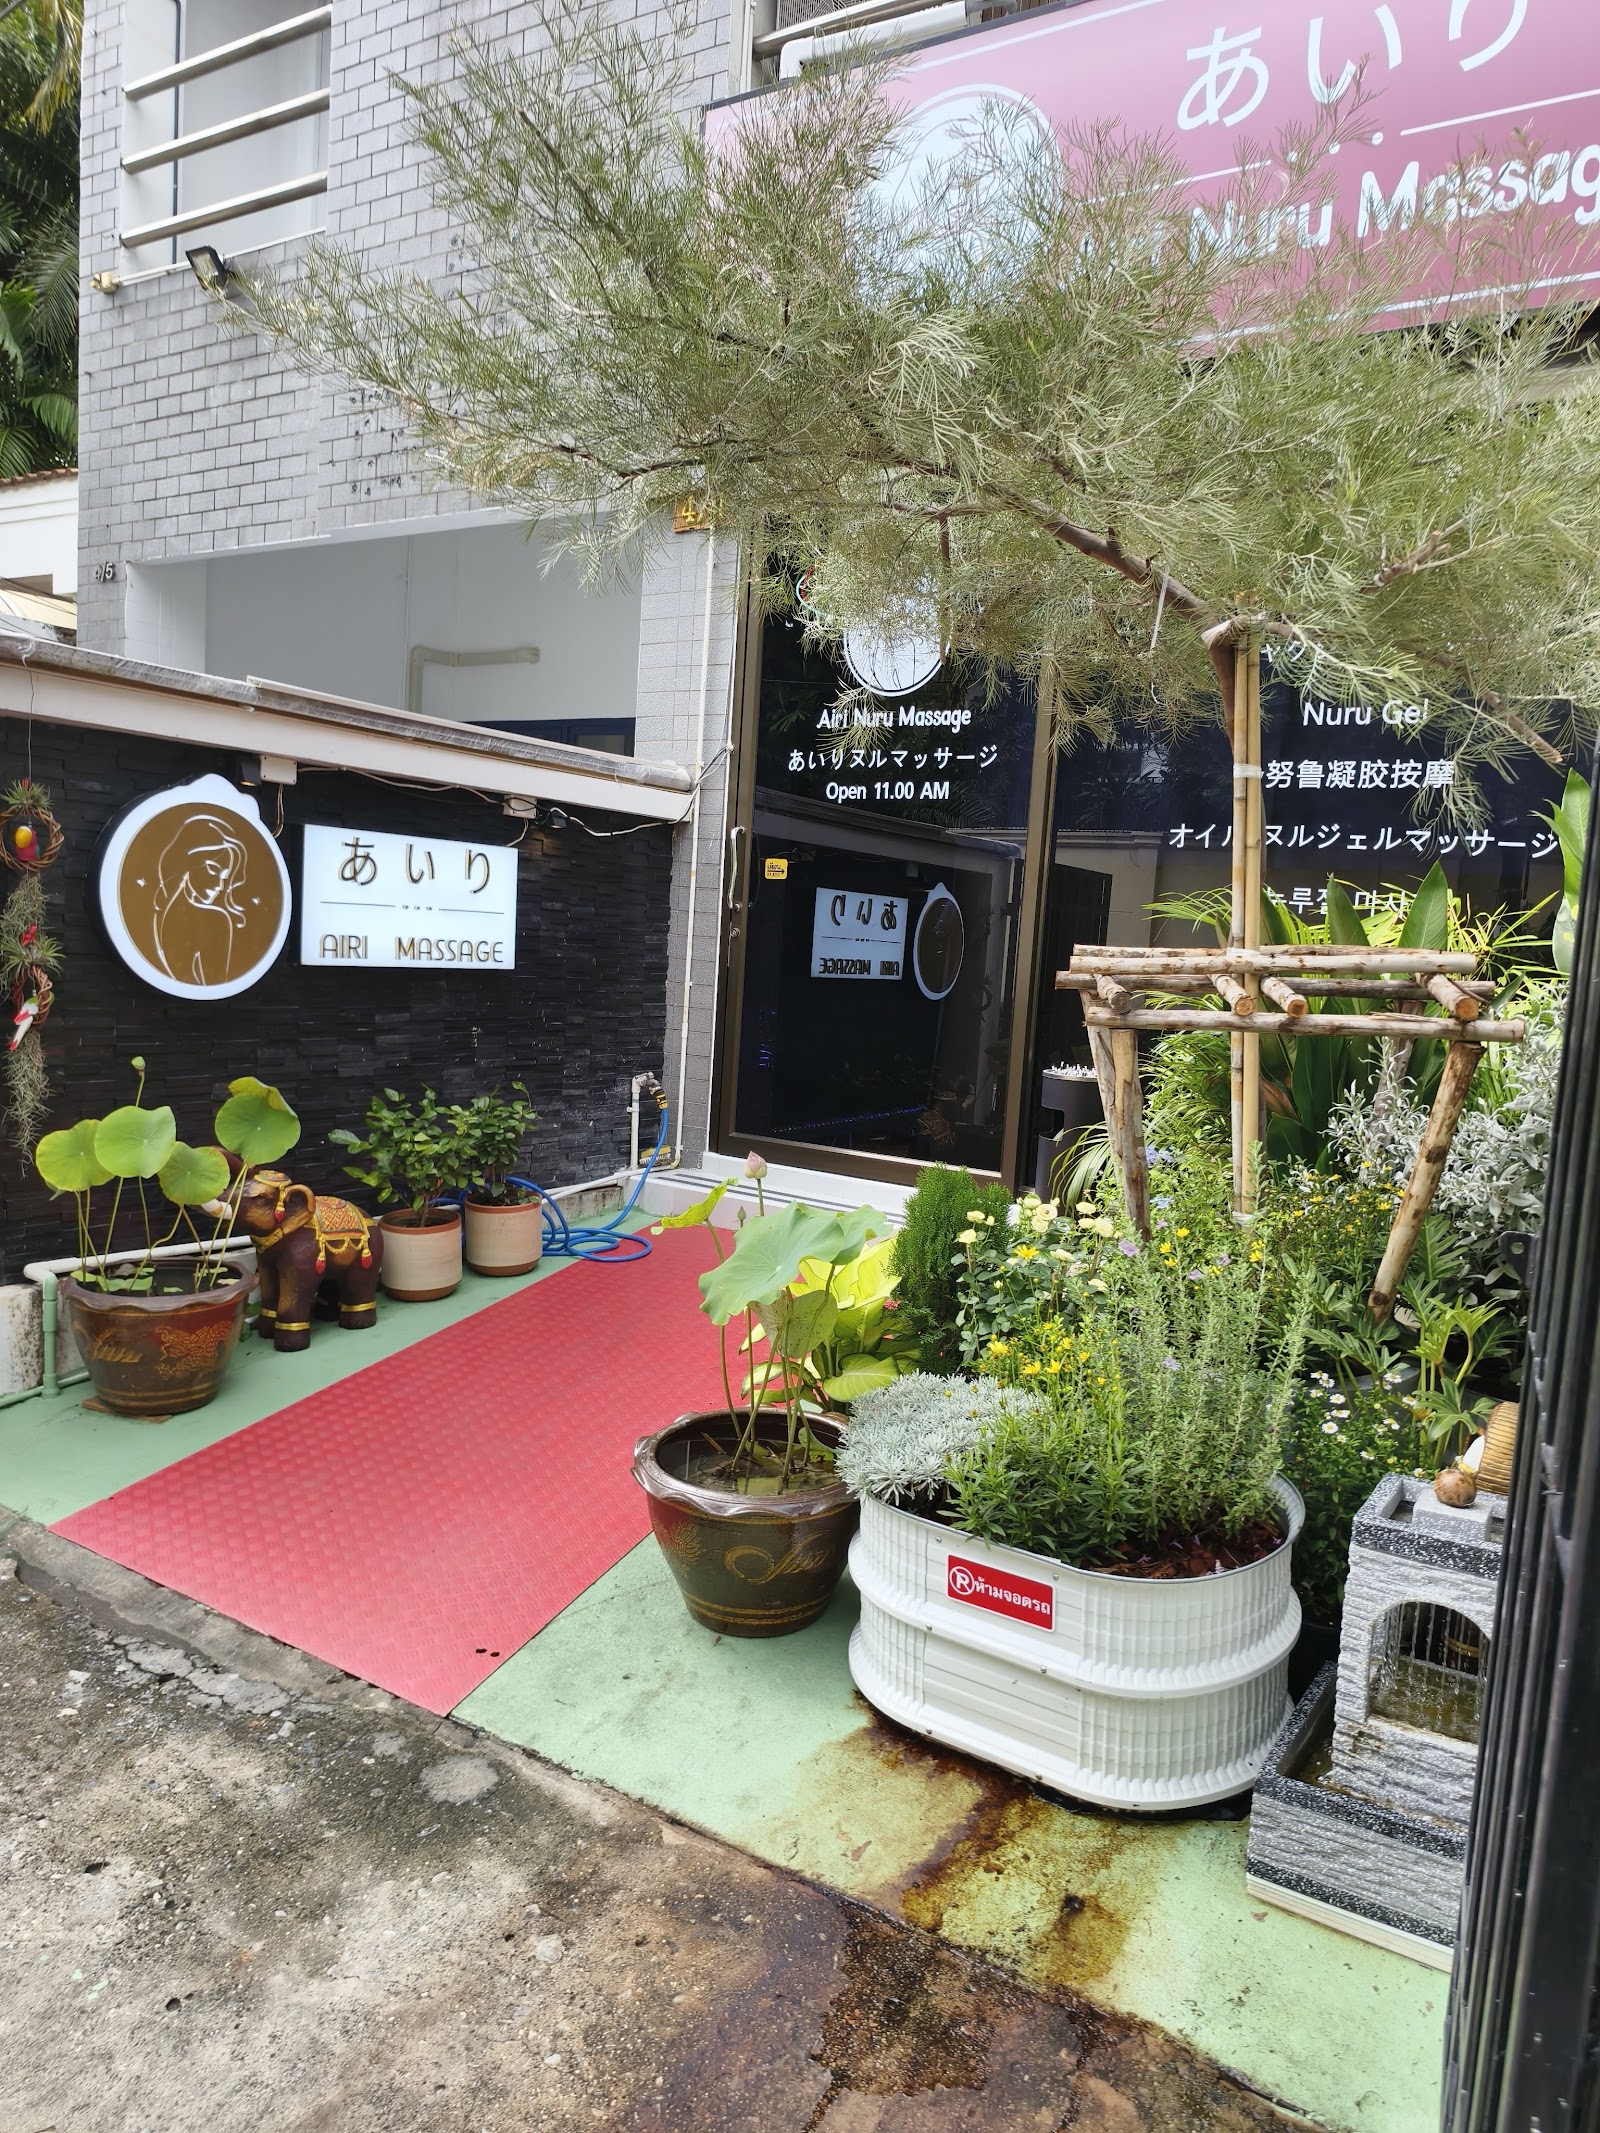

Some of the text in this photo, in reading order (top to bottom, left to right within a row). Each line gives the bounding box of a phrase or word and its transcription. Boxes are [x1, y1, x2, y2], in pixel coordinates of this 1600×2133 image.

[1177, 0, 1528, 131] あいり
[94, 562, 114, 582] 4/5
[816, 706, 971, 734] Airi Nuru Massage
[1303, 698, 1428, 726] Nuru Gel
[788, 744, 998, 772] あいりヌルマッサージ
[1265, 759, 1455, 789] 努鲁凝胶按摩
[826, 781, 949, 803] Open 11.00 AM
[338, 837, 490, 894] あいり
[319, 934, 504, 963] AIRI MASSAGE
[974, 1576, 1051, 1615] ห้ามจอดรถ
